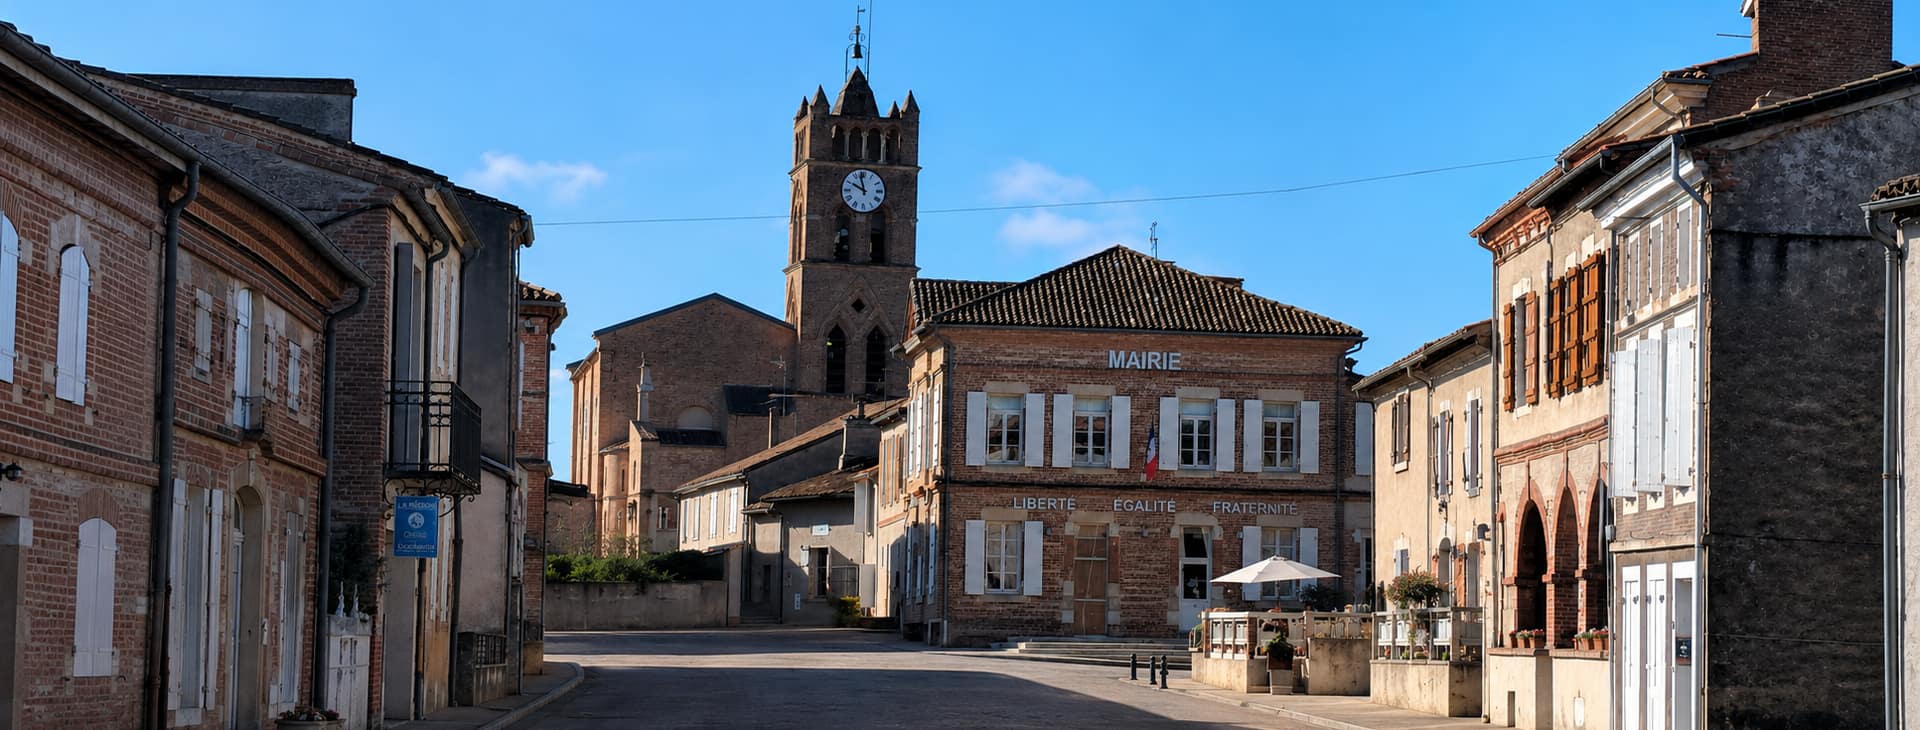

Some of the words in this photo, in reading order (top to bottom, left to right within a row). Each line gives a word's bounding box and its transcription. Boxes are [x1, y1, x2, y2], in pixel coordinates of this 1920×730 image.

[1108, 349, 1182, 371] MAIRIE
[1013, 495, 1077, 510] LIBERTÉ
[1113, 496, 1177, 513] ÉGALITÉ
[1213, 500, 1298, 515] FRATERNITÉ
